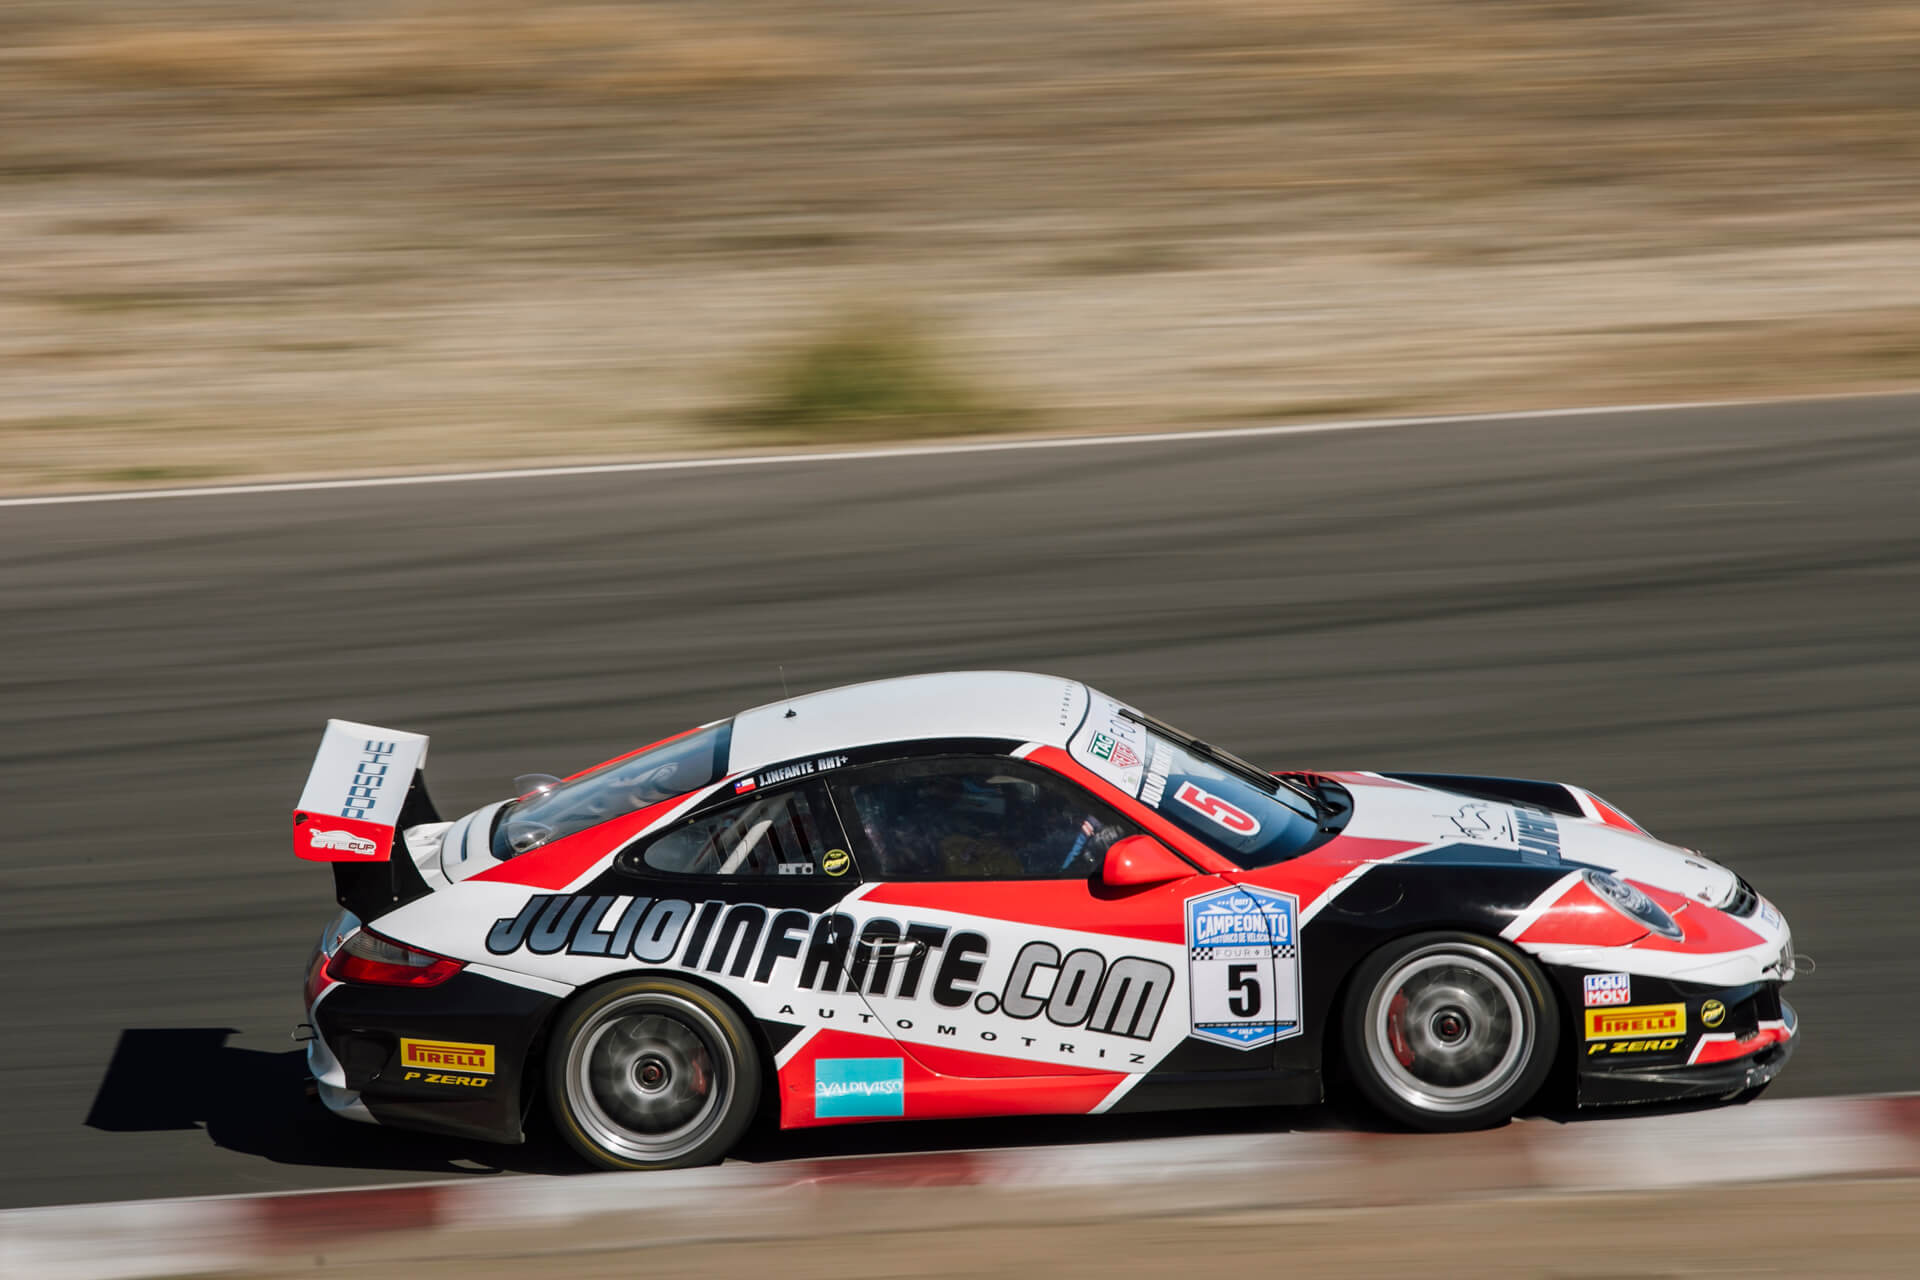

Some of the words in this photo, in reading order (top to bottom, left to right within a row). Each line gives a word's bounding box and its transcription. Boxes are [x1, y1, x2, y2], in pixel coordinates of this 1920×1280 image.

[1093, 733, 1113, 759] TAG
[341, 740, 396, 820] PORSCHE
[1175, 783, 1259, 835] 5
[348, 841, 375, 851] CUP
[1196, 913, 1289, 941] CAMPEONATO
[1228, 964, 1262, 1018] 5
[1587, 975, 1628, 990] LIQUI
[1588, 989, 1629, 1004] MOLY
[1593, 1010, 1677, 1033] PIRELLI
[779, 1003, 1145, 1065] AUTOMOTRIZ
[408, 1043, 486, 1067] PIRELLI
[1588, 1043, 1606, 1055] P
[1610, 1039, 1680, 1054] ZERO
[404, 1072, 421, 1081] P
[424, 1073, 489, 1088] ZERO
